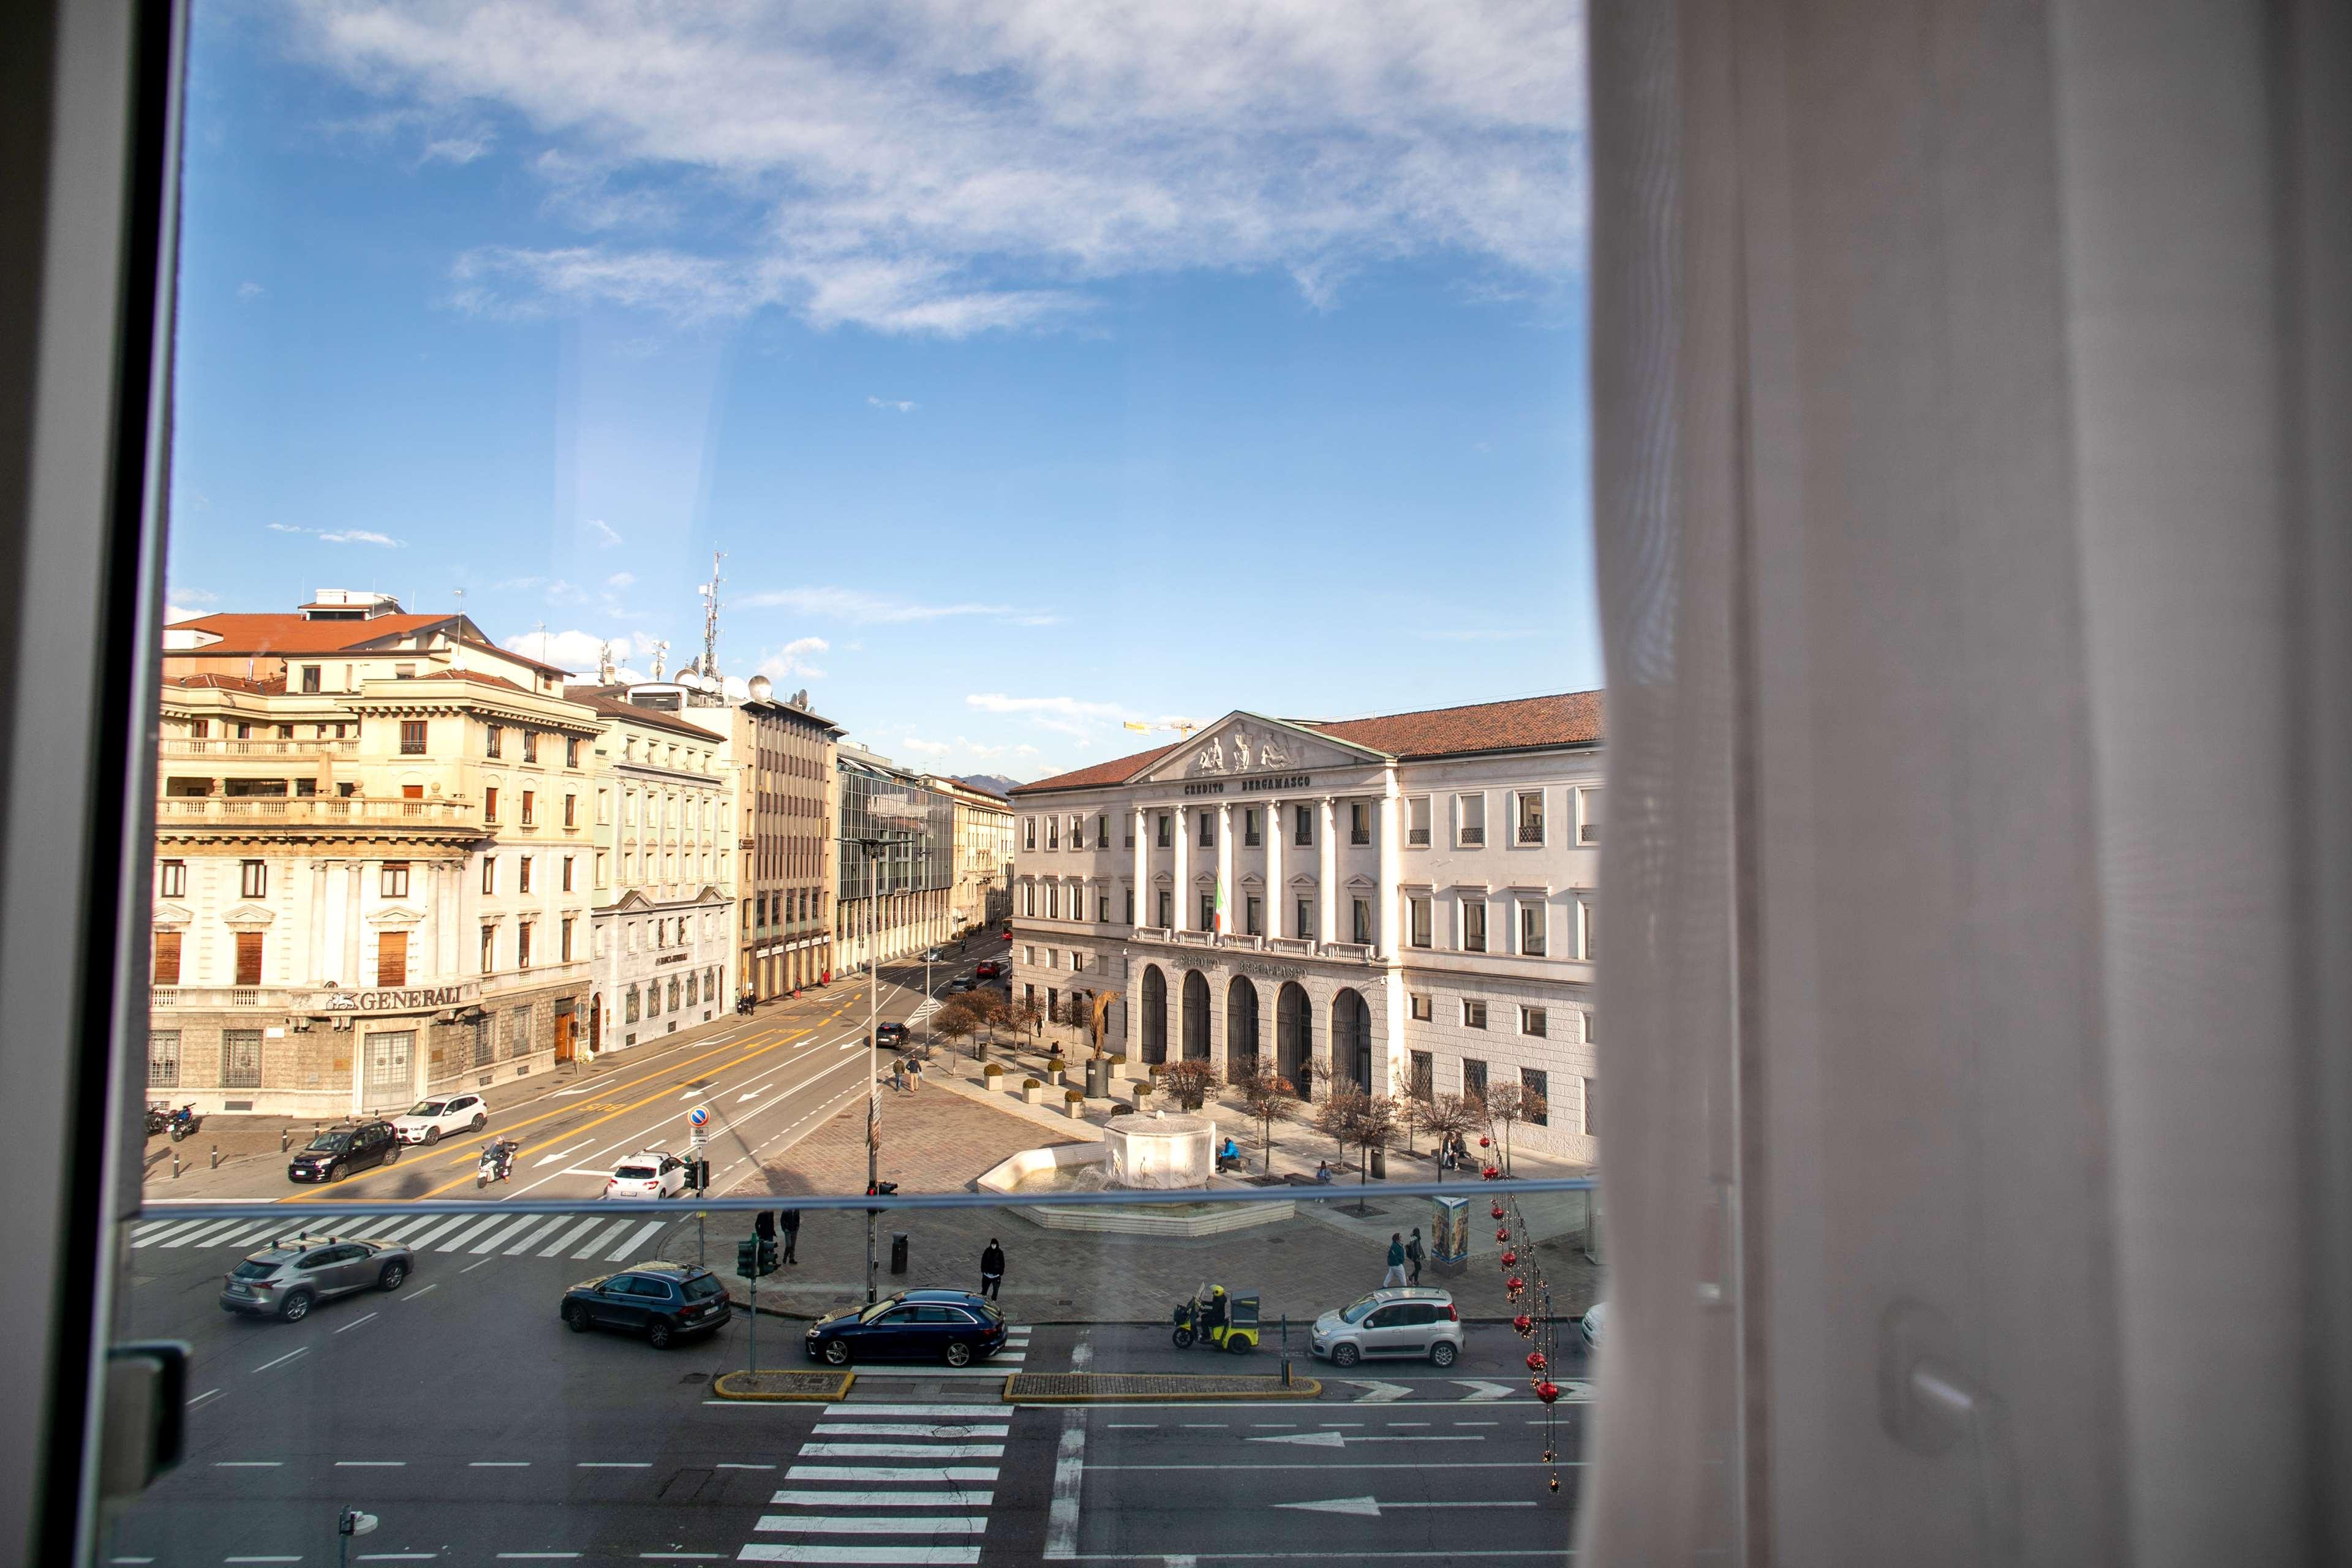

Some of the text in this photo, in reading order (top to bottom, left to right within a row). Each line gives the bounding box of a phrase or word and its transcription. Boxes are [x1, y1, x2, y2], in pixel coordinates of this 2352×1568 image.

[1184, 776, 1311, 795] CREDITO BERGAMASCO
[360, 986, 462, 1010] GENERALI
